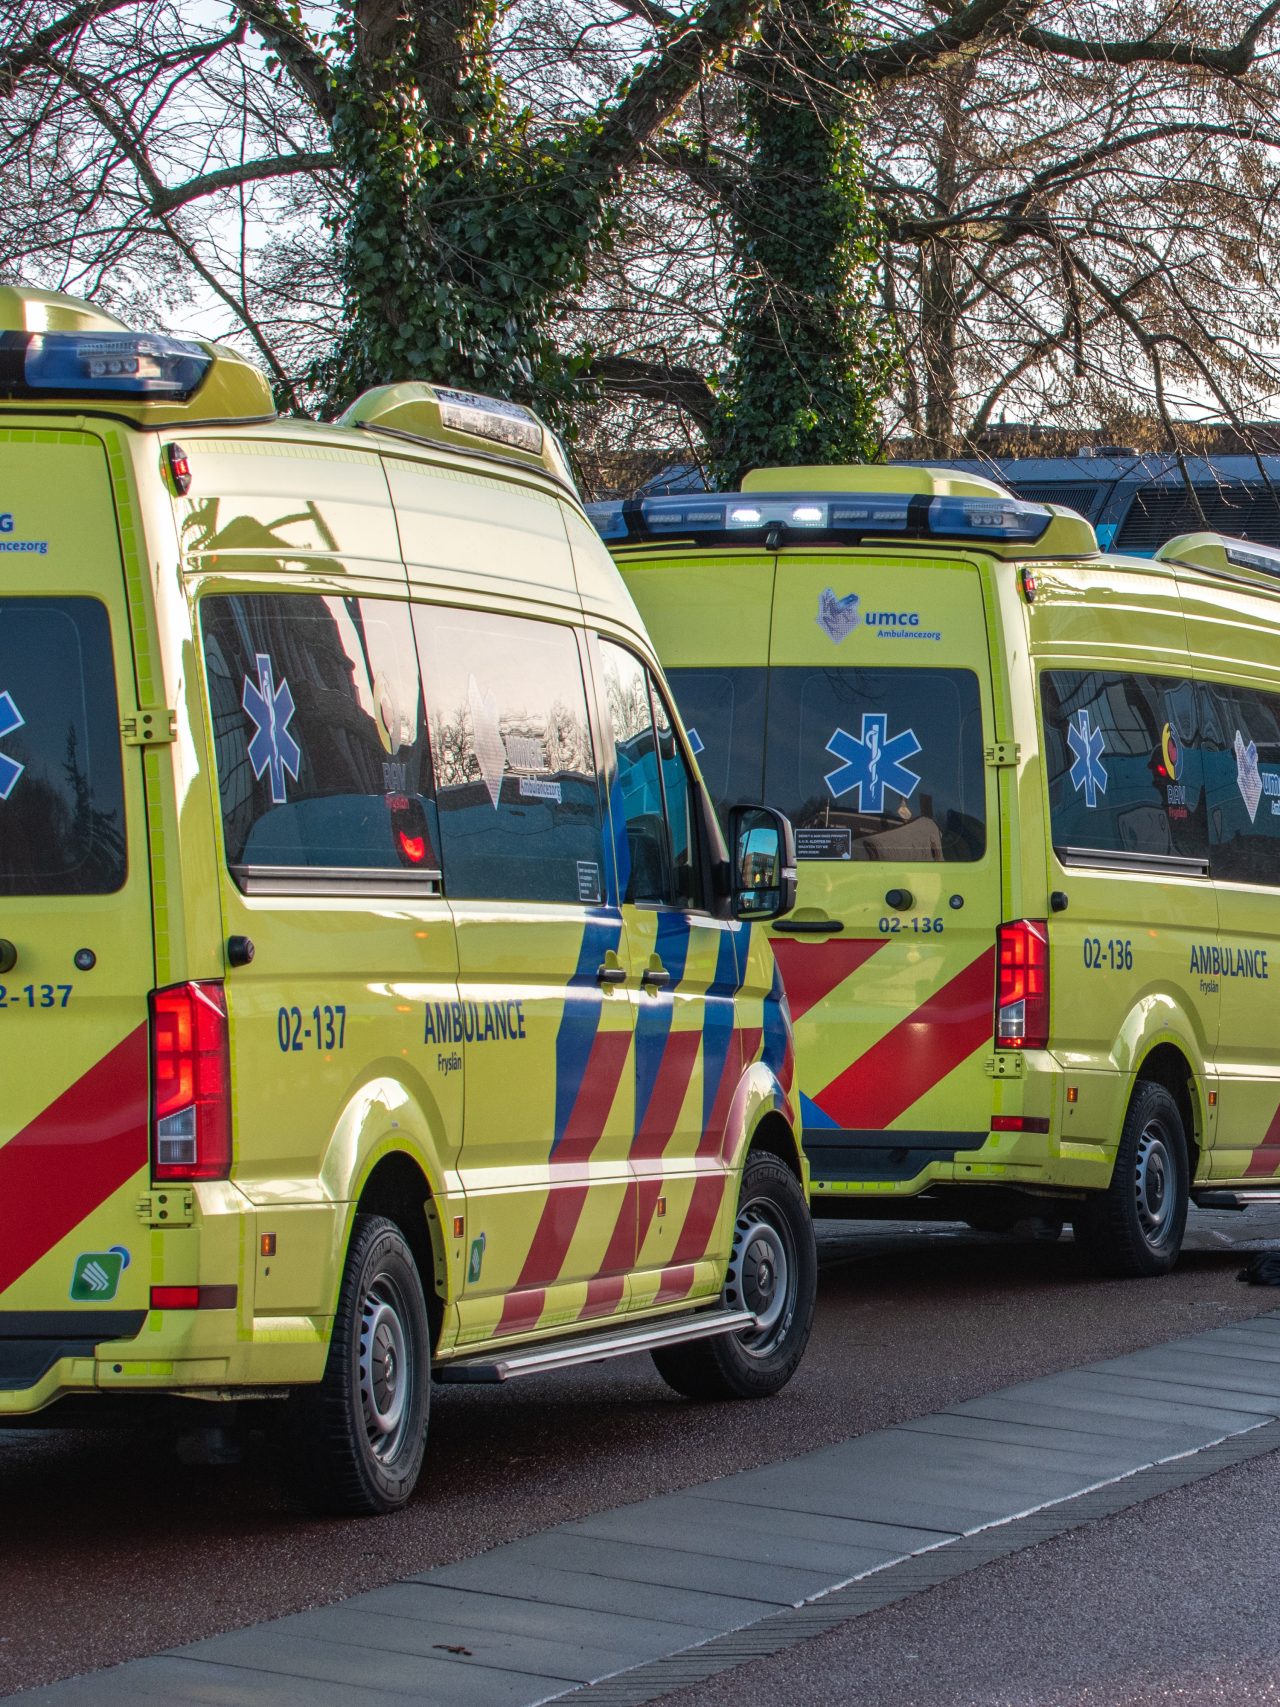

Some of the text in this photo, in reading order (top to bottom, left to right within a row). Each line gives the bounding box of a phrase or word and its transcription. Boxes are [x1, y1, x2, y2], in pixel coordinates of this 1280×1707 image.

[877, 630, 941, 641] Ambulancezorg
[879, 917, 944, 933] 02-136
[1083, 938, 1133, 970] 02-136
[1190, 944, 1269, 979] AMBULANCE
[277, 1005, 346, 1052] 02-137
[424, 999, 526, 1044] AMBULANCE
